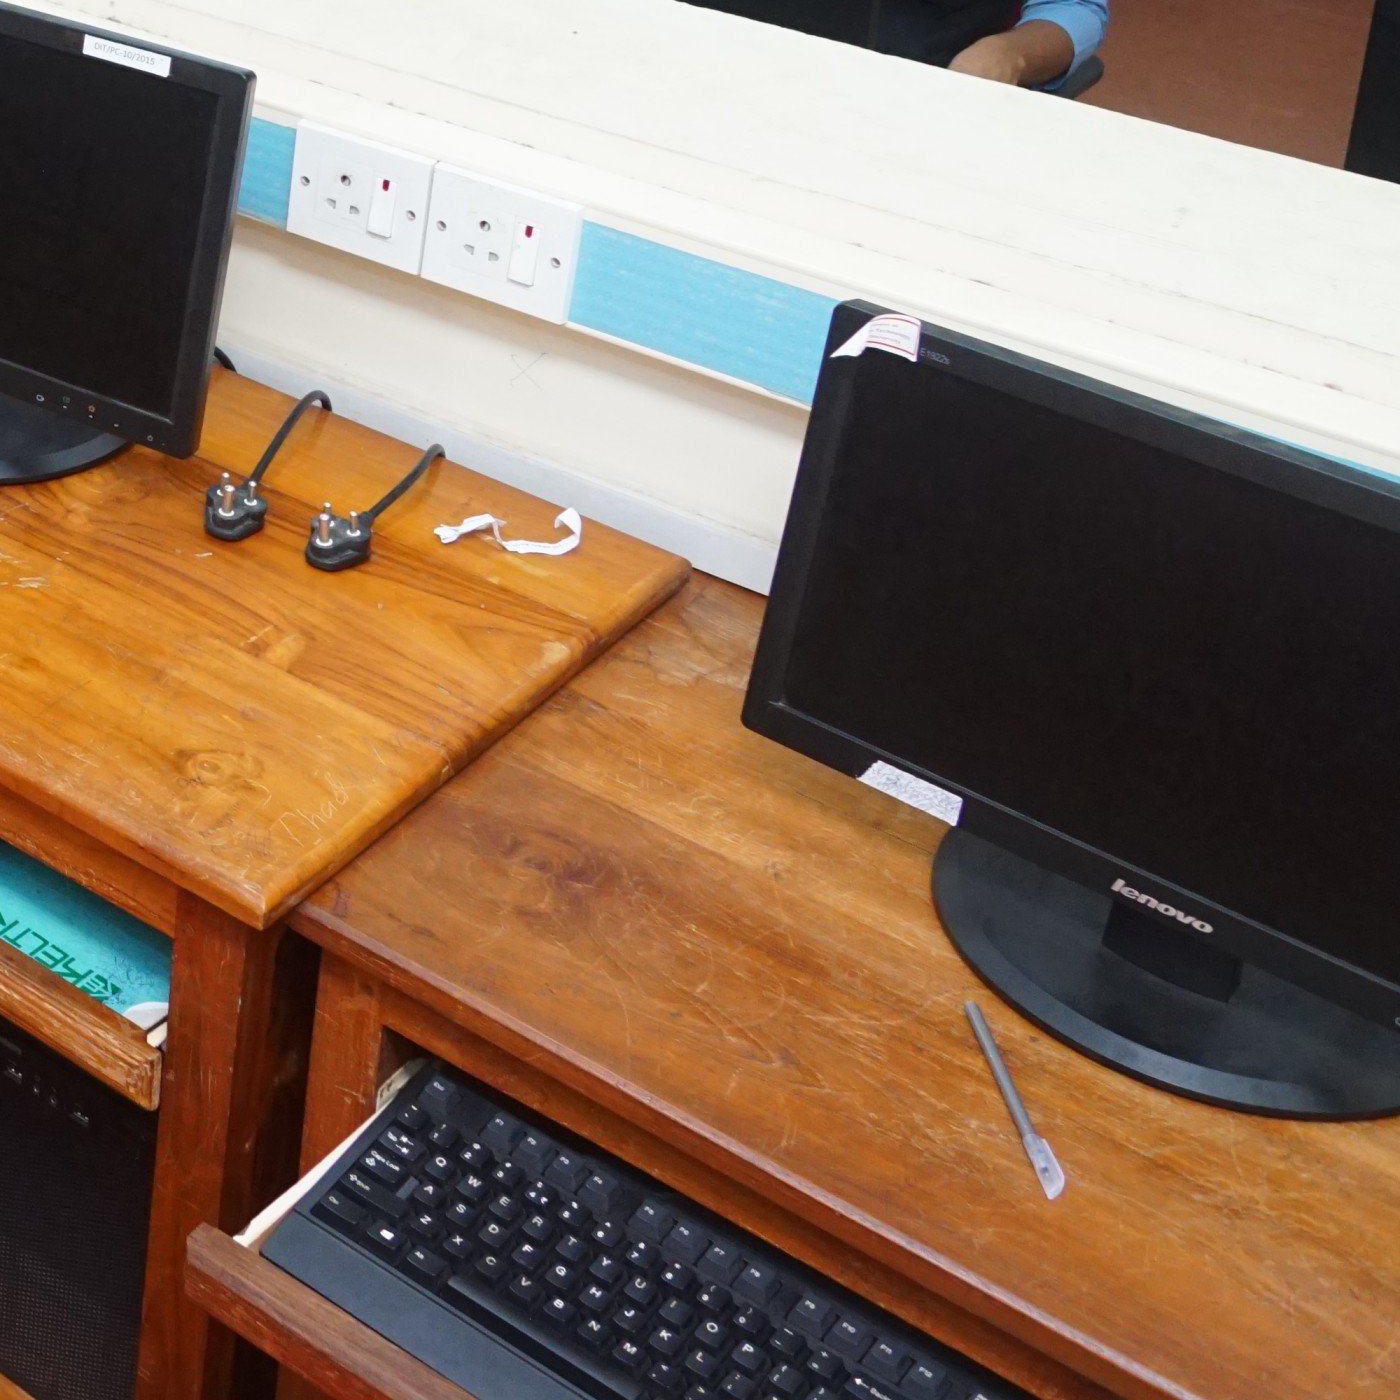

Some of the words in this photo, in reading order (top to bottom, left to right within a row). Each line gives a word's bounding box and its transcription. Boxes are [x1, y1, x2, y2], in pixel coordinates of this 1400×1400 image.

[94, 41, 155, 67] DIT/PC-10/2015
[1111, 877, 1215, 935] lenovo
[420, 1215, 431, 1224] Z
[453, 1236, 463, 1245] X
[486, 1257, 496, 1265] C
[522, 1277, 531, 1286] V
[589, 1321, 600, 1331] N
[624, 1343, 637, 1354] M
[424, 1186, 433, 1194] A
[456, 1204, 466, 1213] S
[489, 1224, 498, 1233] D
[556, 1266, 566, 1276] G
[590, 1287, 601, 1297] H
[660, 1330, 671, 1340] K
[696, 1352, 703, 1362] L
[436, 1157, 446, 1167] Q
[468, 1176, 481, 1187] W
[499, 1197, 510, 1206] E
[532, 1216, 543, 1226] R
[569, 1236, 577, 1245] T
[602, 1257, 611, 1266] Y
[635, 1278, 646, 1288] U
[707, 1323, 718, 1332] O
